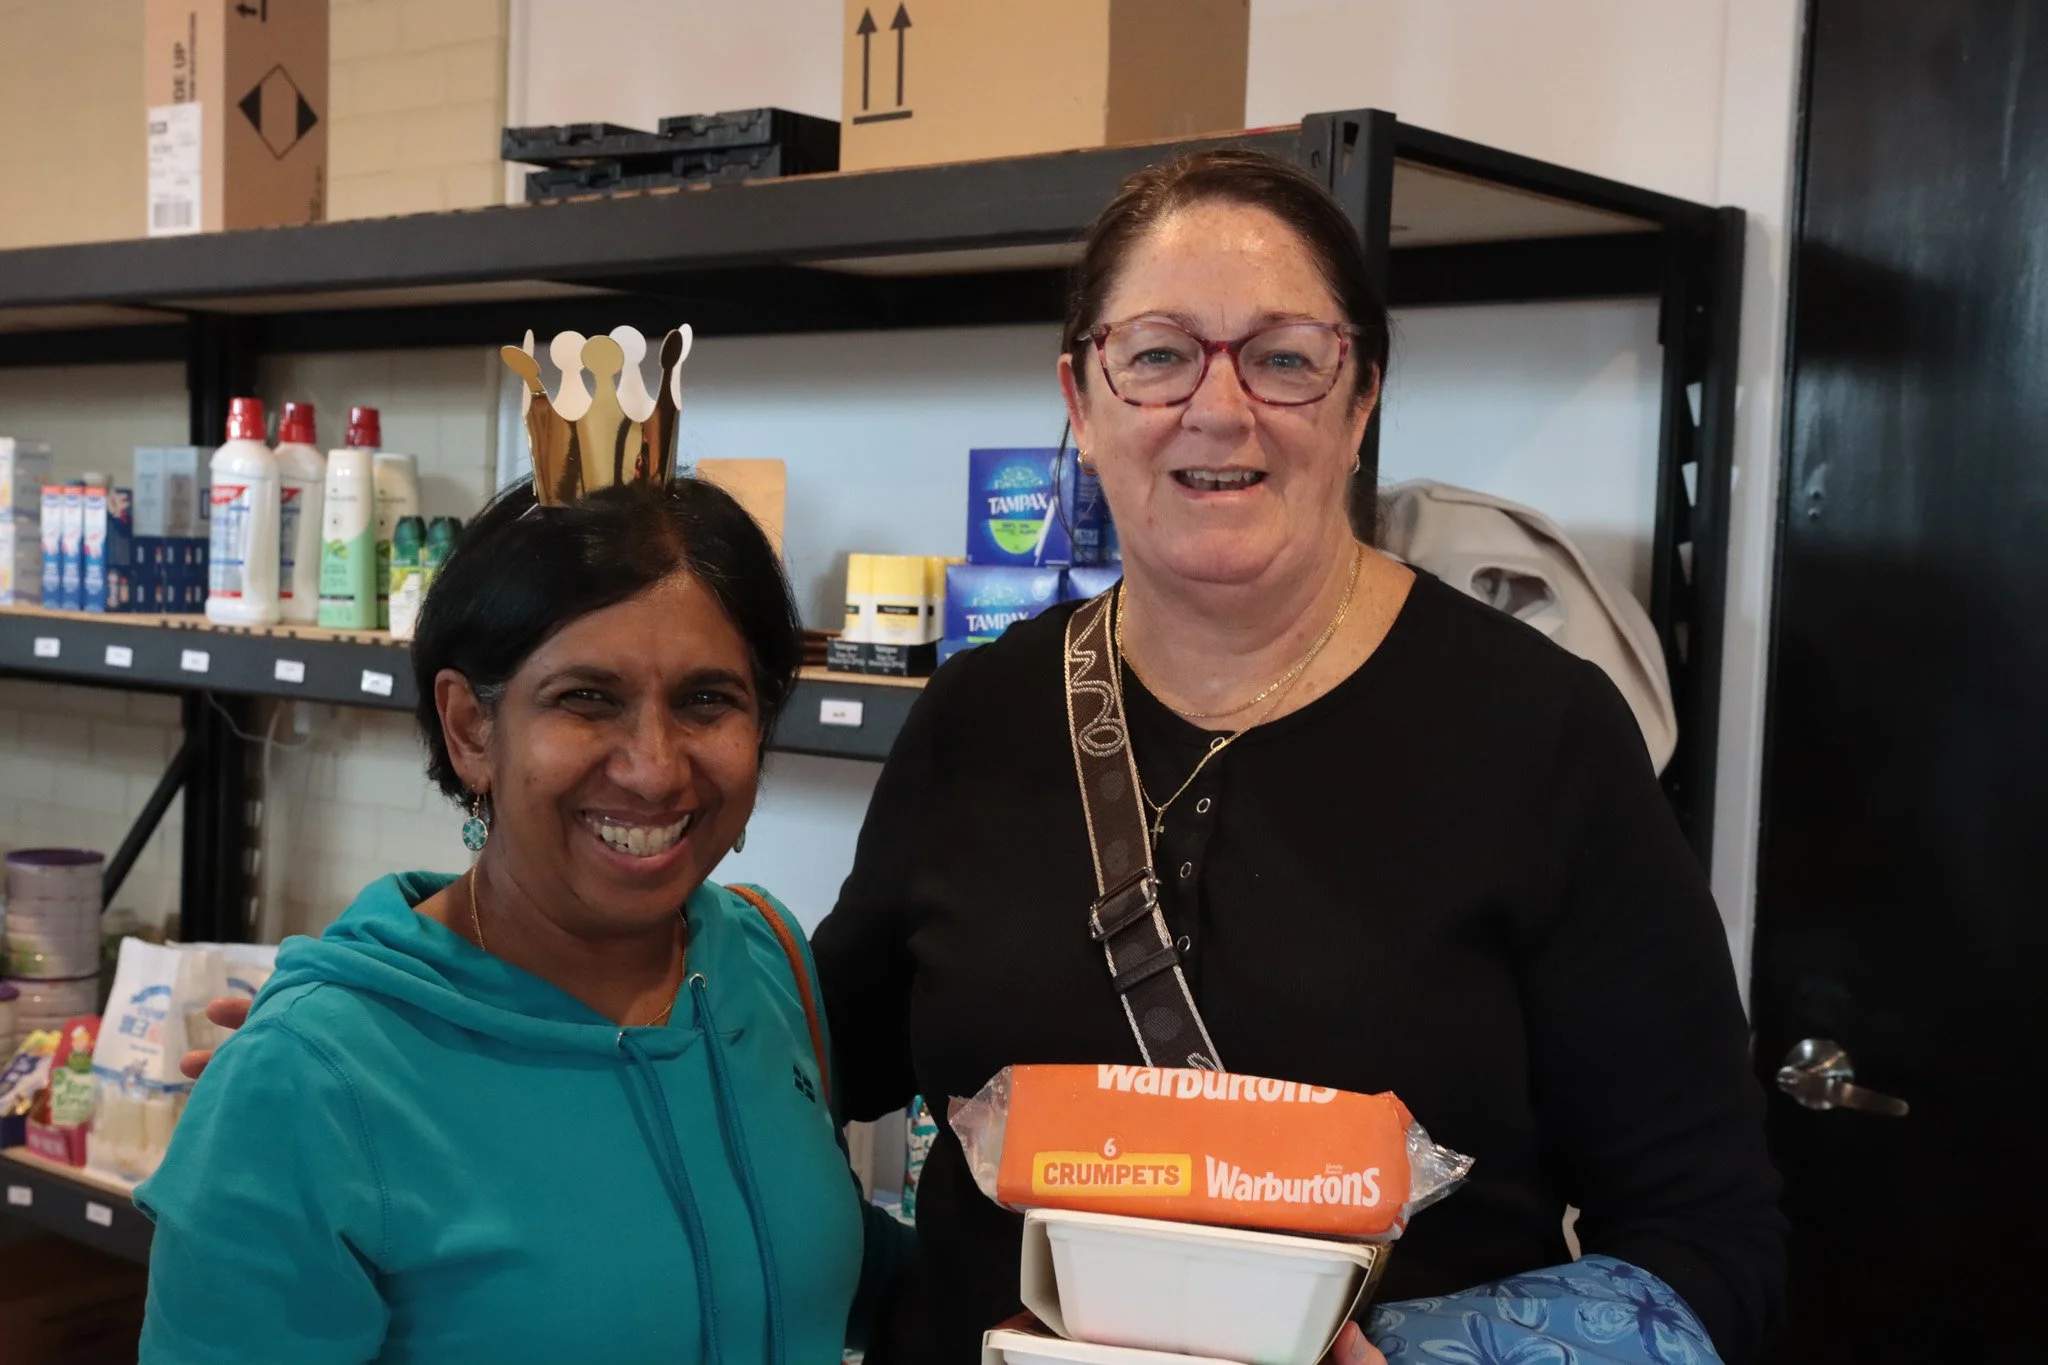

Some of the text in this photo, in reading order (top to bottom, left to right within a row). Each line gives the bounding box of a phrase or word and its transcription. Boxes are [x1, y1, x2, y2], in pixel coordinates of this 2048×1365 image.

[173, 41, 187, 69] UP
[987, 493, 1048, 515] TAMPAX
[1103, 1138, 1117, 1157] 6
[1043, 1162, 1180, 1187] CRUMPETS
[1205, 1155, 1380, 1207] Warburtons
